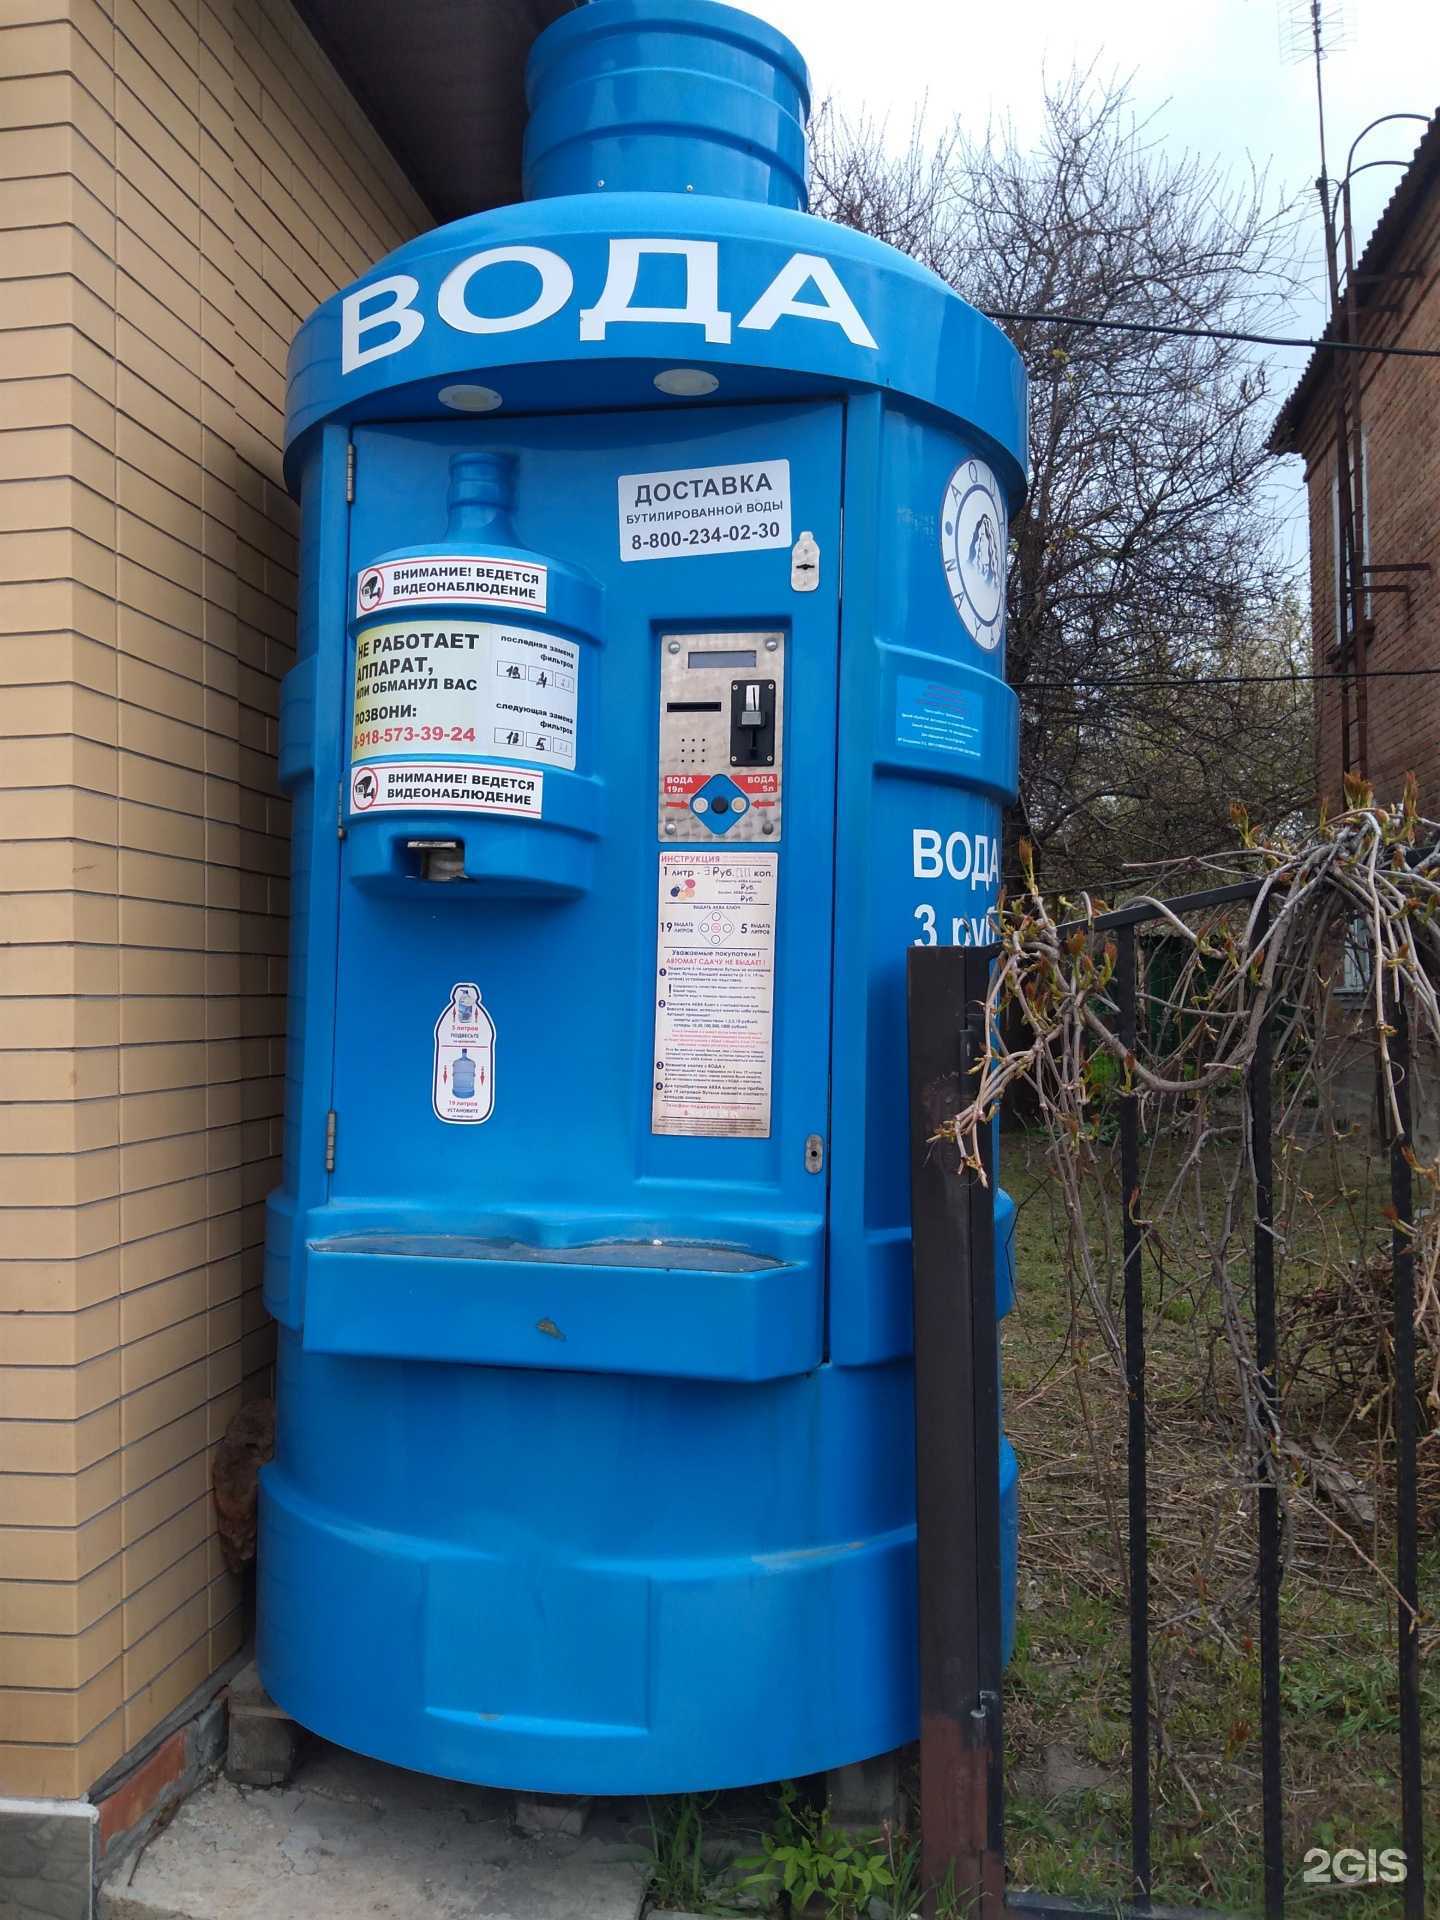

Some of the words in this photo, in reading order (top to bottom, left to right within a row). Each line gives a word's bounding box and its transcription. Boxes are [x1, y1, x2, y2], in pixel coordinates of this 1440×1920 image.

[341, 238, 879, 375] ВОДА
[634, 472, 773, 507] ДОСТАВКА
[626, 503, 743, 524] БУТИЛИРОВАННОЙ
[746, 500, 783, 514] ВОДЫ
[631, 521, 780, 550] 8-800-234-02-30
[392, 566, 472, 582] ВНИМАНИЕ!
[476, 566, 539, 585] ВЕДЕТСЯ
[392, 581, 537, 600] ВИДЕОНАБЛЮДЕНИЕ
[358, 641, 369, 661] НЕ
[372, 632, 480, 655] РАБОТАЕТ
[500, 635, 548, 650] последняя
[549, 644, 574, 659] замена
[357, 656, 434, 683] АППАРАТ,
[540, 653, 574, 670] фильтров
[357, 685, 370, 701] ИЛИ
[372, 678, 438, 695] ОБМАНУЛ
[443, 678, 478, 691] ВАС
[355, 704, 417, 726] ПОЗВОНИ:
[495, 702, 548, 718] следующая
[548, 712, 574, 725] замена
[539, 720, 574, 736] фильтров
[387, 773, 467, 785] ВНИМАНИЕ!
[472, 774, 535, 792] ВЕДЕТСЯ
[666, 776, 694, 784] ВОДА
[666, 785, 684, 793] 19л
[747, 775, 775, 785] ВОДА
[761, 785, 775, 793] 5л
[386, 787, 532, 806] ВИДЕОНАБЛЮДЕНИЕ
[661, 855, 720, 864] ИНСТРУКЦИЯ
[912, 828, 1000, 891] ВОДА
[663, 866, 668, 876] 1
[660, 921, 673, 932] 19
[740, 923, 748, 933] 5
[914, 904, 938, 946] 3
